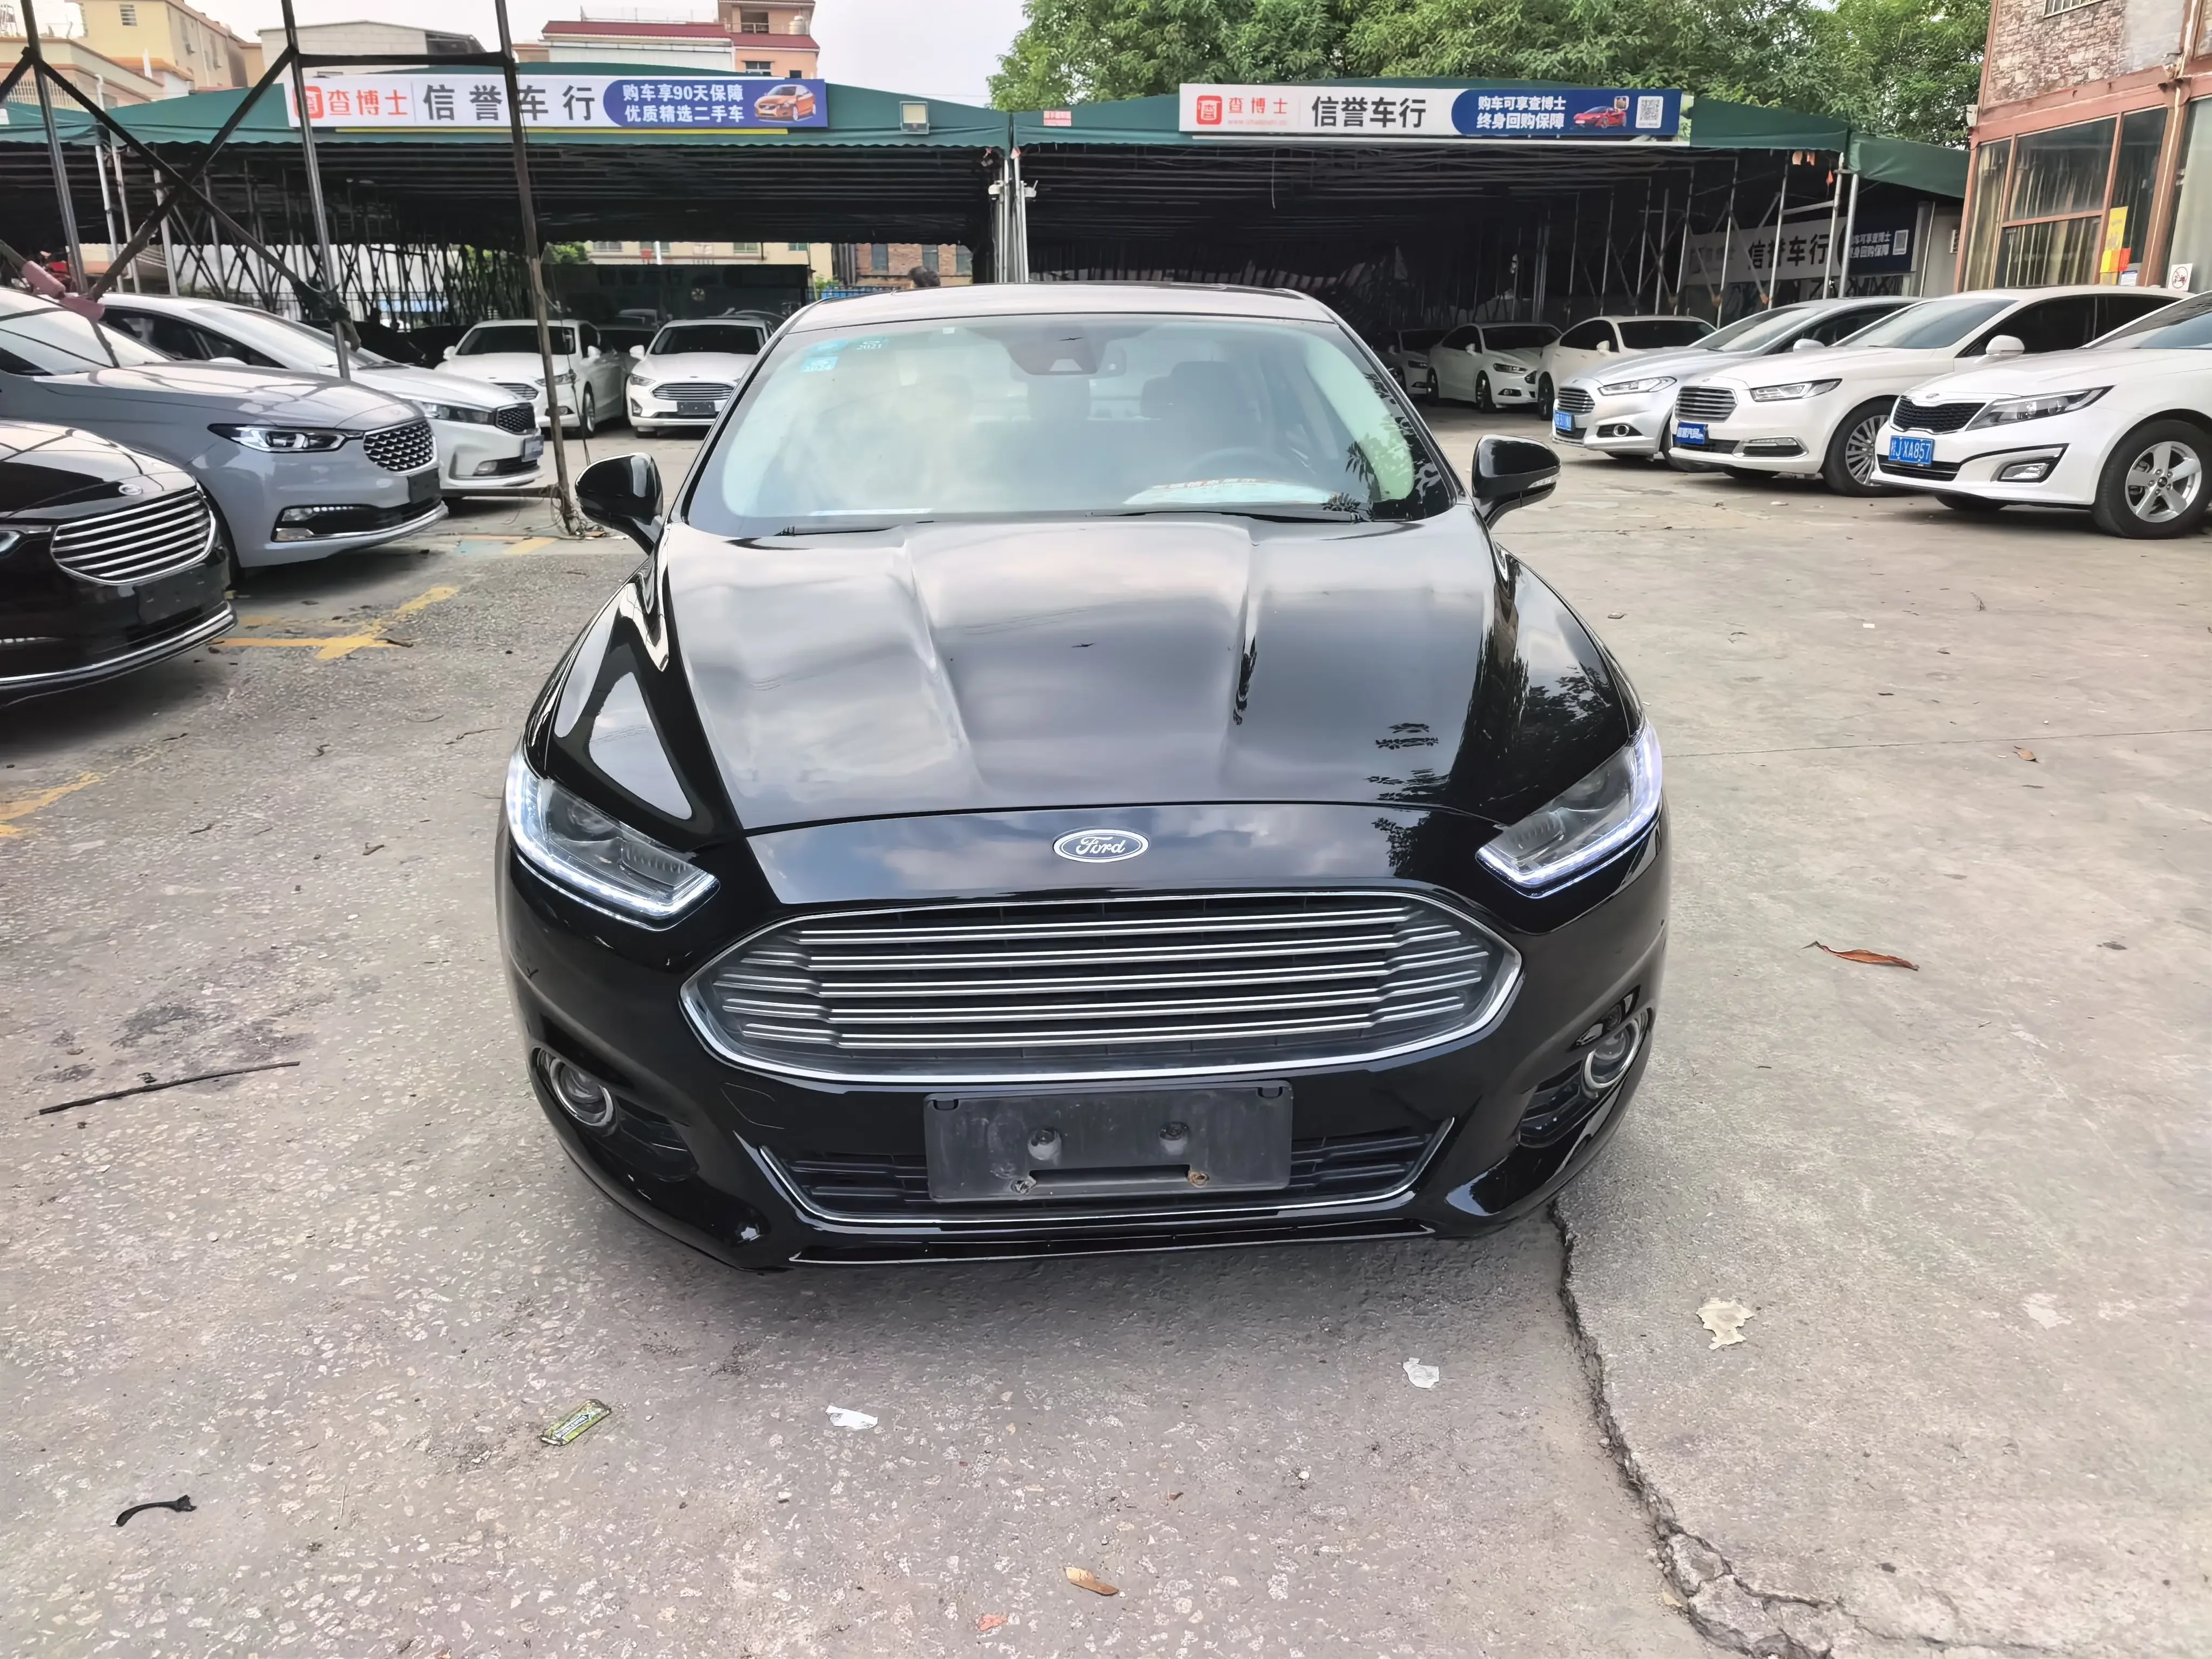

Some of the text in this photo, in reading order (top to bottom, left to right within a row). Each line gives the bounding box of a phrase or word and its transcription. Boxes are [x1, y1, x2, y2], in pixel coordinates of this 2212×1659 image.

[623, 84, 744, 102] 购车享90天保障
[327, 89, 408, 116] 查博士
[423, 84, 595, 121] 信誉车行
[1228, 97, 1288, 114] 查博士
[1478, 96, 1566, 111] 购车可享查博士
[625, 105, 744, 123] 优质精选二手车
[1311, 96, 1426, 128] 信誉车行
[1476, 112, 1564, 130] 终身回购保障
[1075, 836, 1126, 855] Ford
